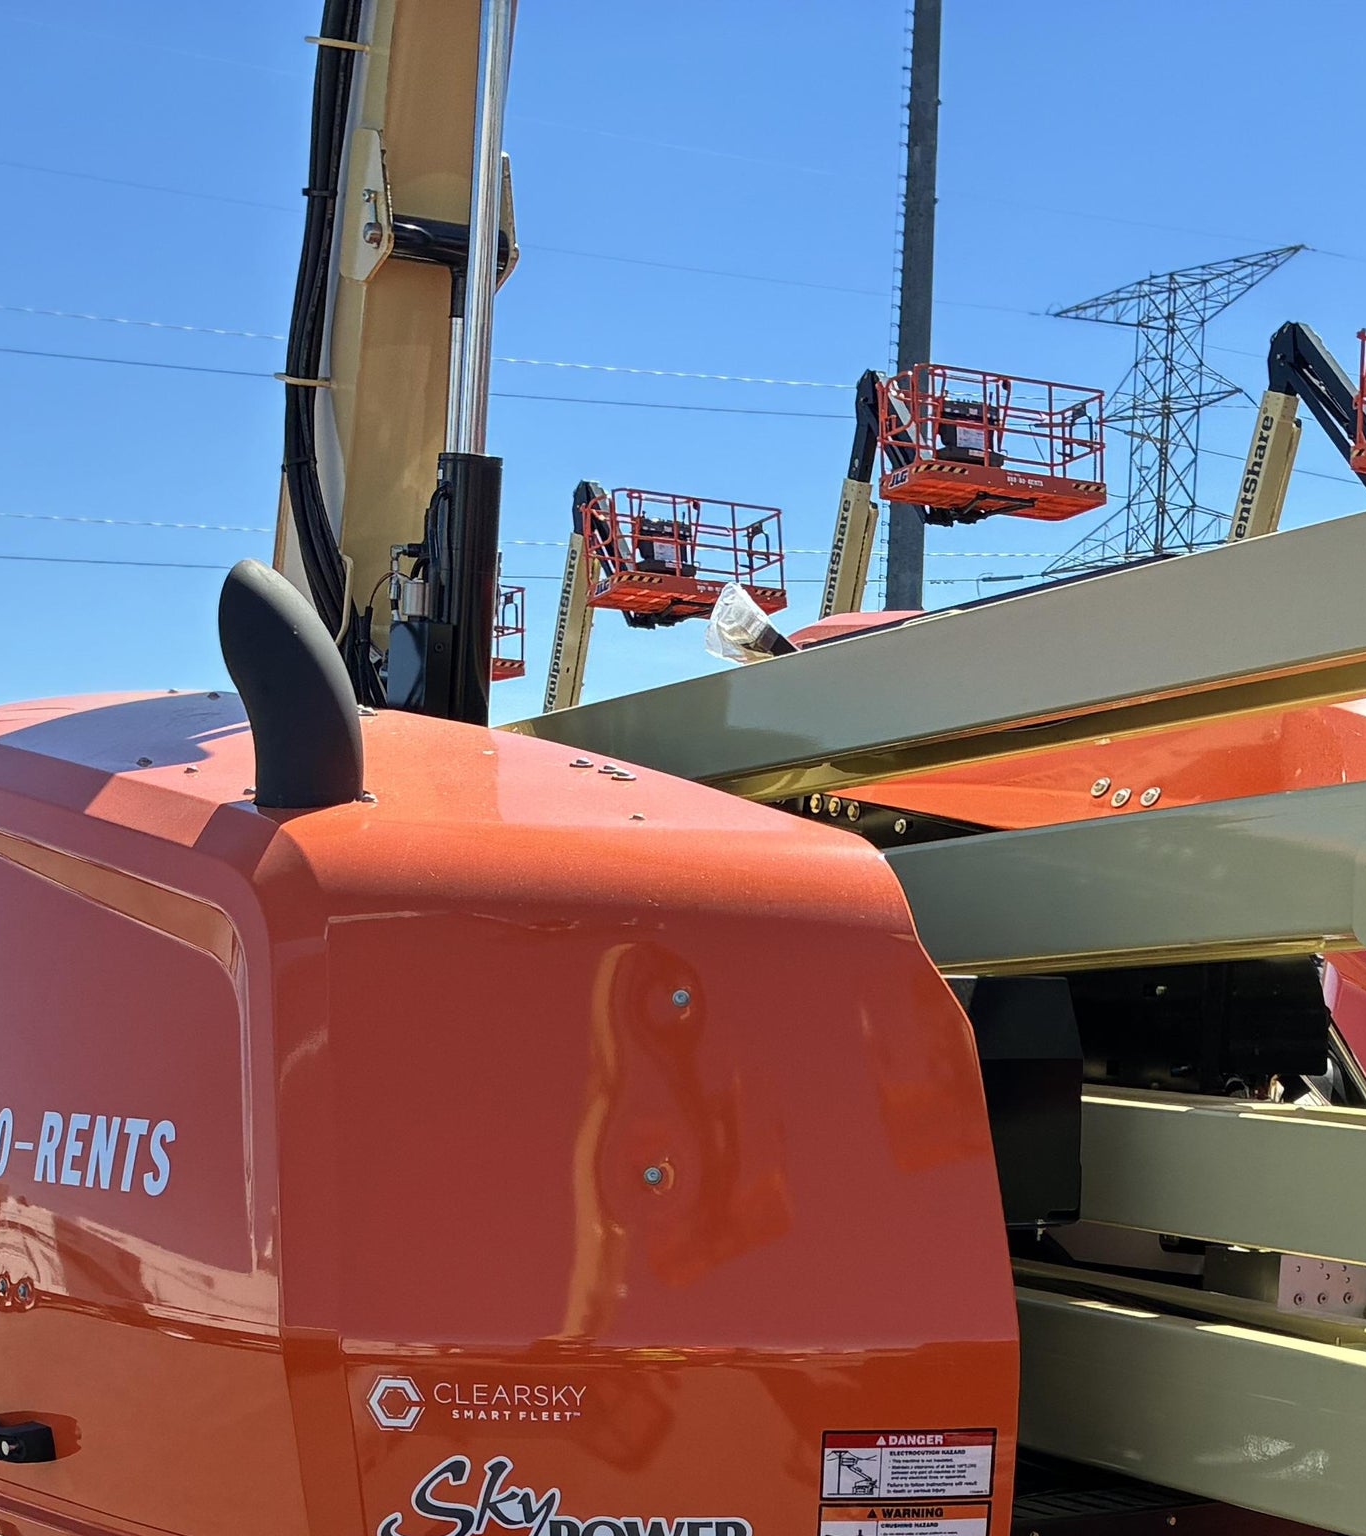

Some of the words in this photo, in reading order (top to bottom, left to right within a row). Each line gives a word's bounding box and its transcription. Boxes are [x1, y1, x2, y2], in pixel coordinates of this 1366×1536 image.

[890, 470, 908, 487] JLG
[1235, 414, 1274, 541] entShare
[433, 1382, 587, 1407] CLEARSKY
[451, 1409, 512, 1421] SMART
[888, 1434, 944, 1446] DANGER
[881, 1507, 944, 1519] WARNING
